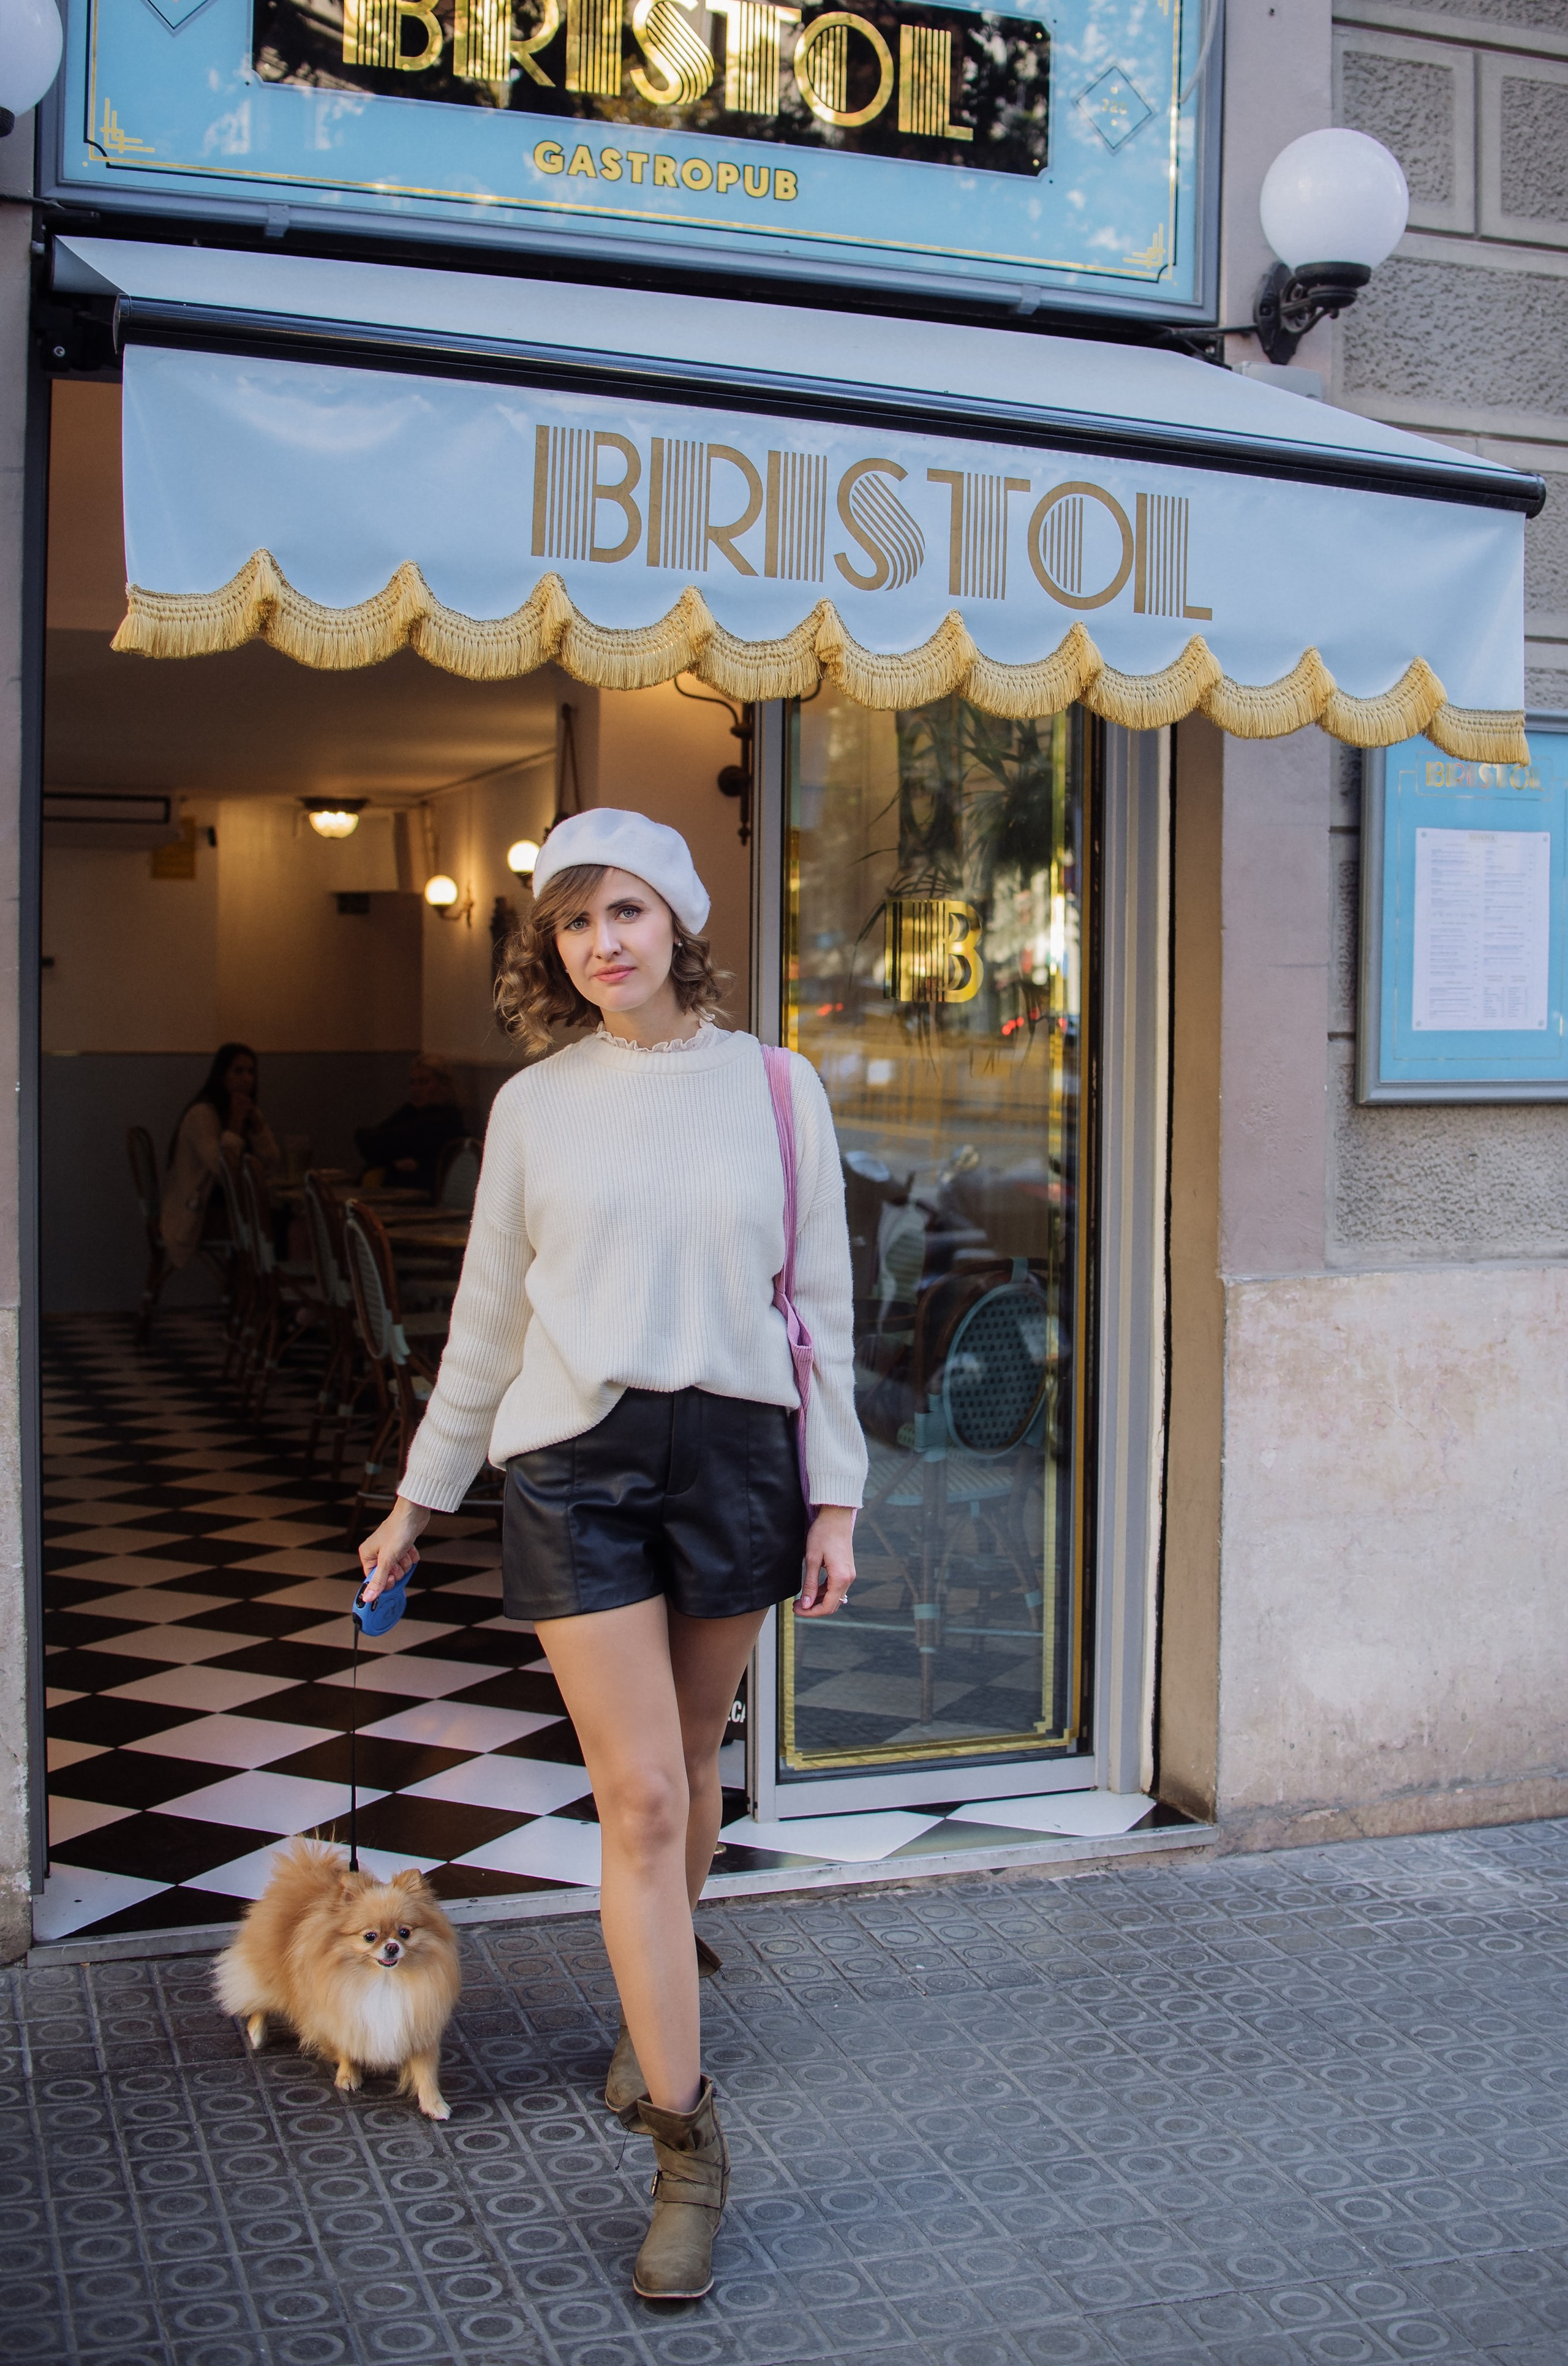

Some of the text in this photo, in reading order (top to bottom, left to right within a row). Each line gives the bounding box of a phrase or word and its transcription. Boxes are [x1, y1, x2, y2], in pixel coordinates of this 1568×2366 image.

[343, 0, 973, 140] BRISTOL
[533, 140, 799, 202] GASTROPUB
[531, 425, 1213, 620] BRISTOL
[1426, 762, 1545, 791] BRISTOL
[884, 899, 984, 1003] B
